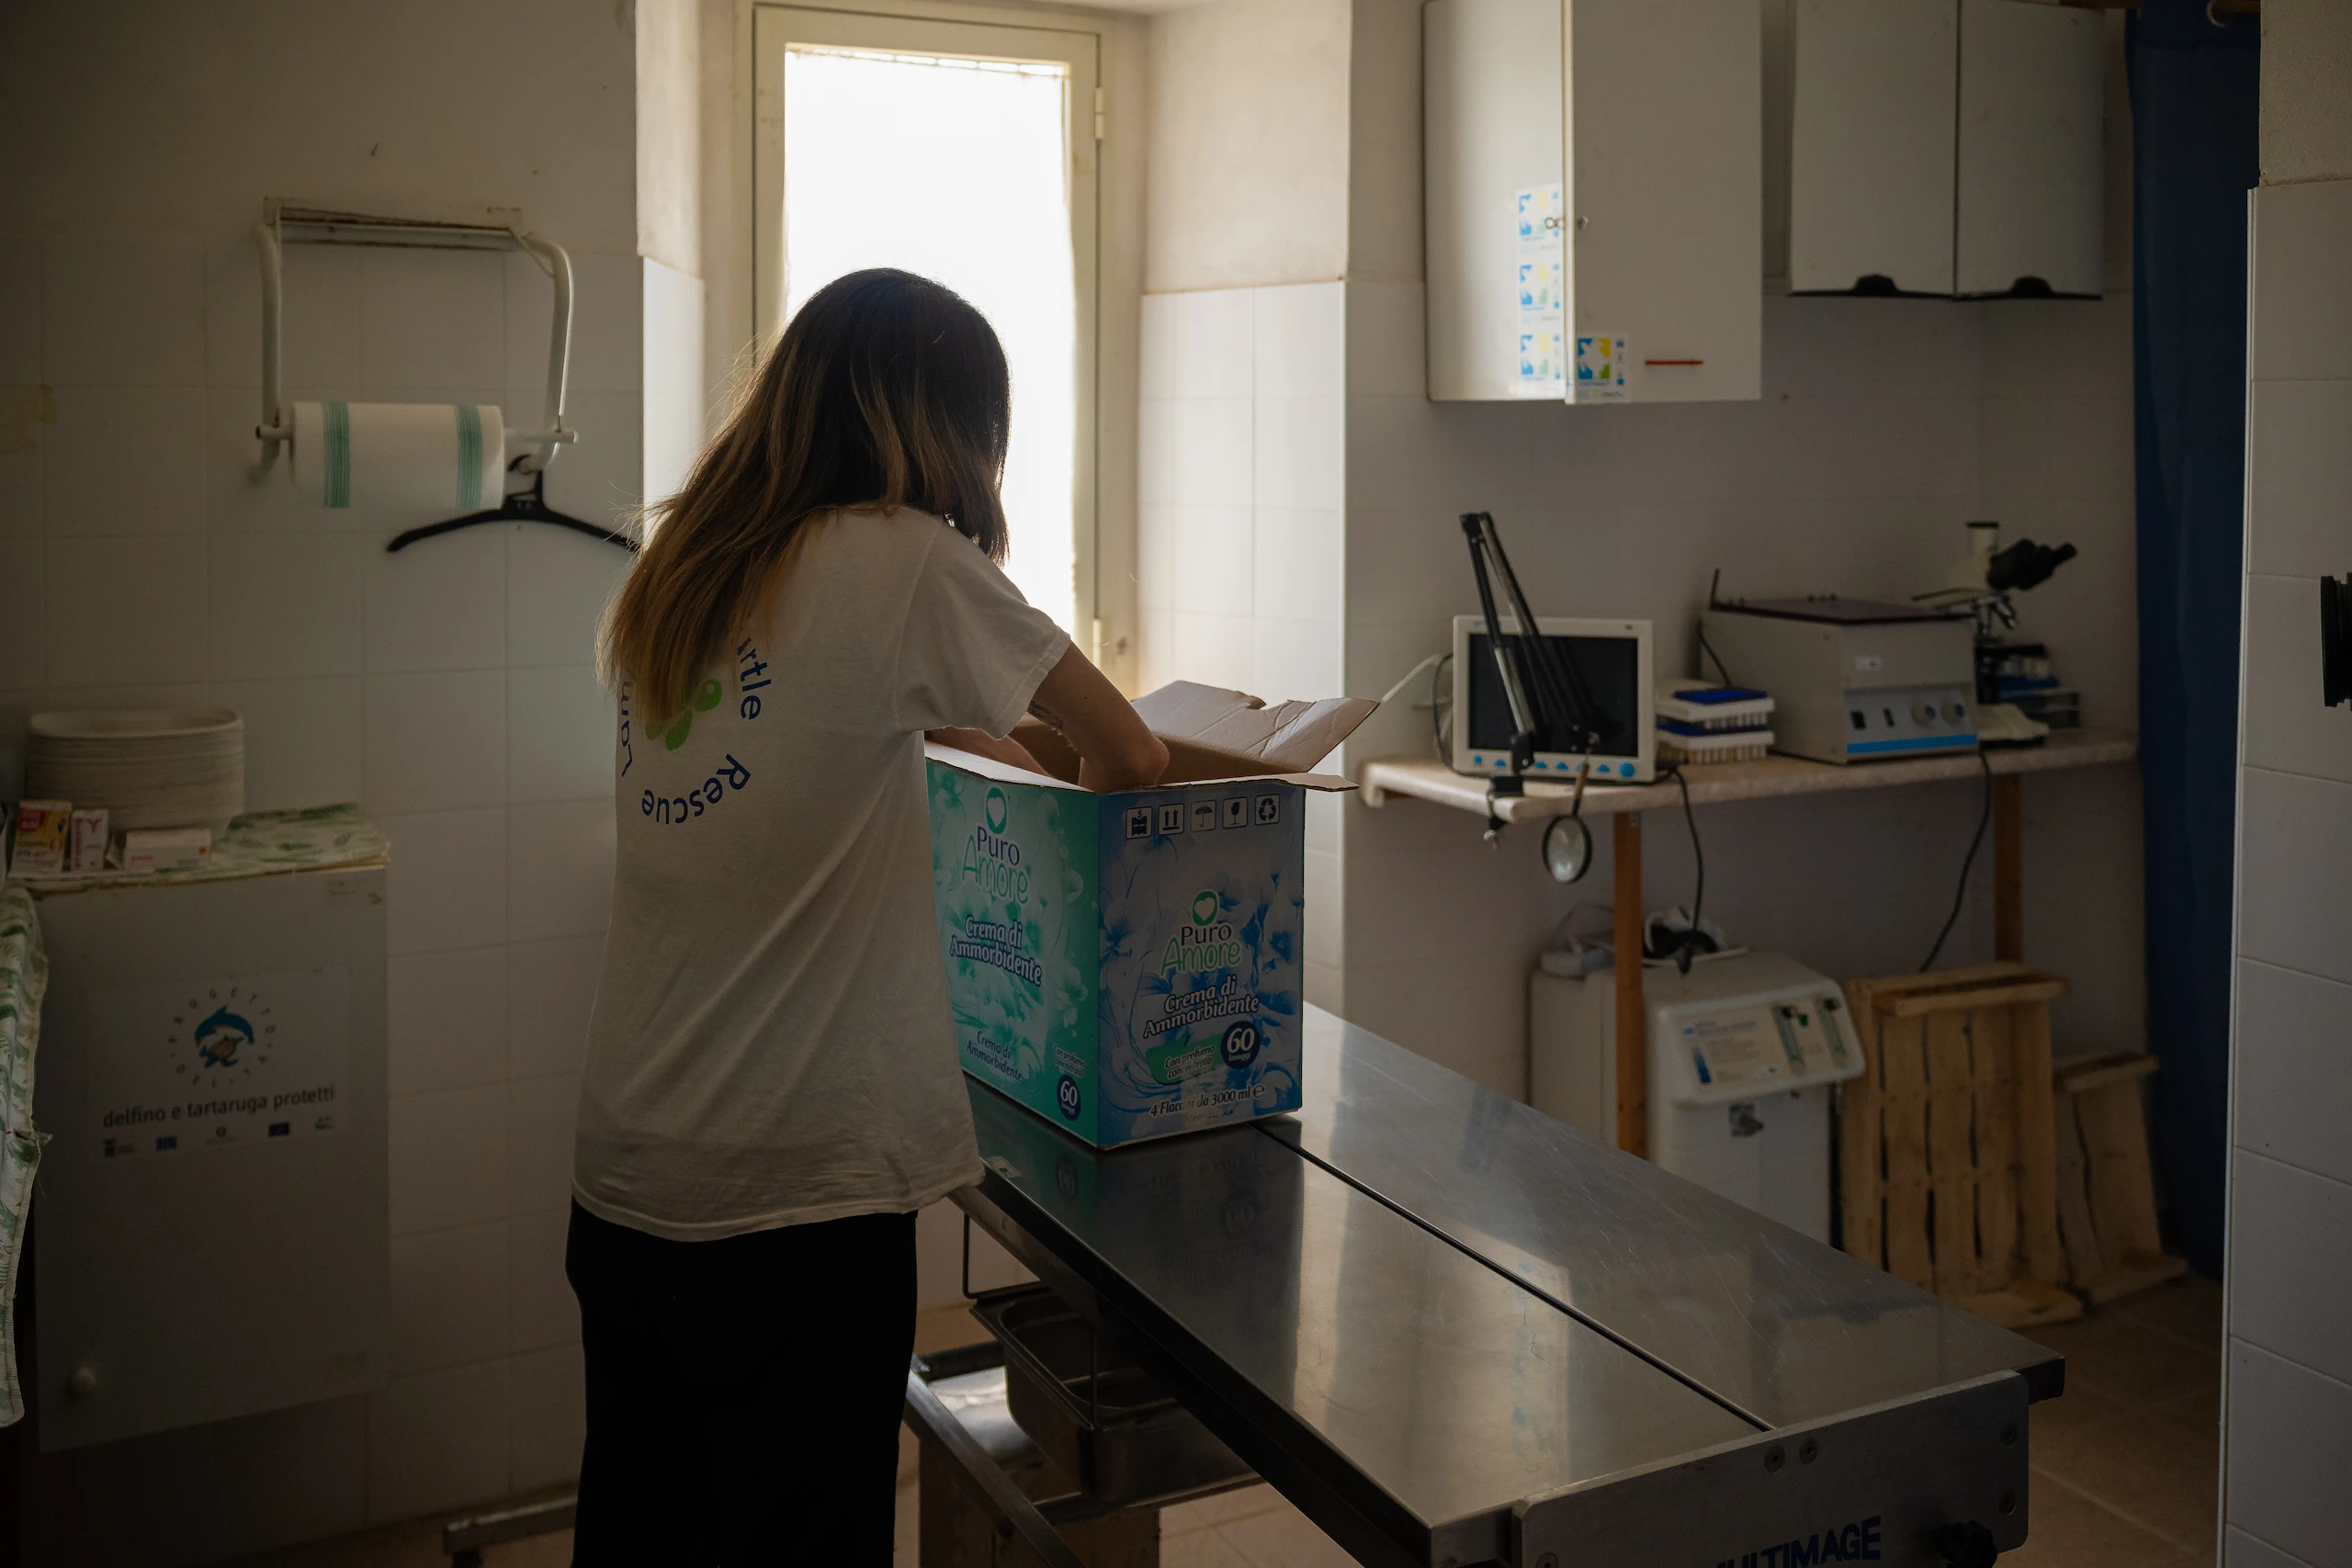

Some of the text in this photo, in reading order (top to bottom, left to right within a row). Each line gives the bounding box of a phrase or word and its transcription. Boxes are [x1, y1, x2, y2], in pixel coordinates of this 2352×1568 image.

[641, 753, 752, 825] Rescue
[978, 826, 1020, 865] Puro
[962, 835, 1029, 904] Amore
[965, 914, 1023, 949] Crema di
[1181, 925, 1232, 946] Puro
[949, 935, 1042, 987] Ammorbidente
[1160, 937, 1240, 976] Amore
[1164, 974, 1238, 1014] Crema di
[1143, 994, 1260, 1039] Ammorbidente
[977, 1031, 1011, 1059] Crema di
[1053, 1044, 1063, 1056] Con
[1165, 1045, 1216, 1068] Con profumo
[1227, 1028, 1255, 1054] 60
[967, 1041, 1023, 1082] Ammorbidente
[103, 1084, 334, 1128] delfino e tartaruga protetti
[1060, 1080, 1078, 1106] 60
[1150, 1104, 1158, 1117] 4
[1211, 1089, 1236, 1106] 3000
[1238, 1085, 1250, 1100] ml
